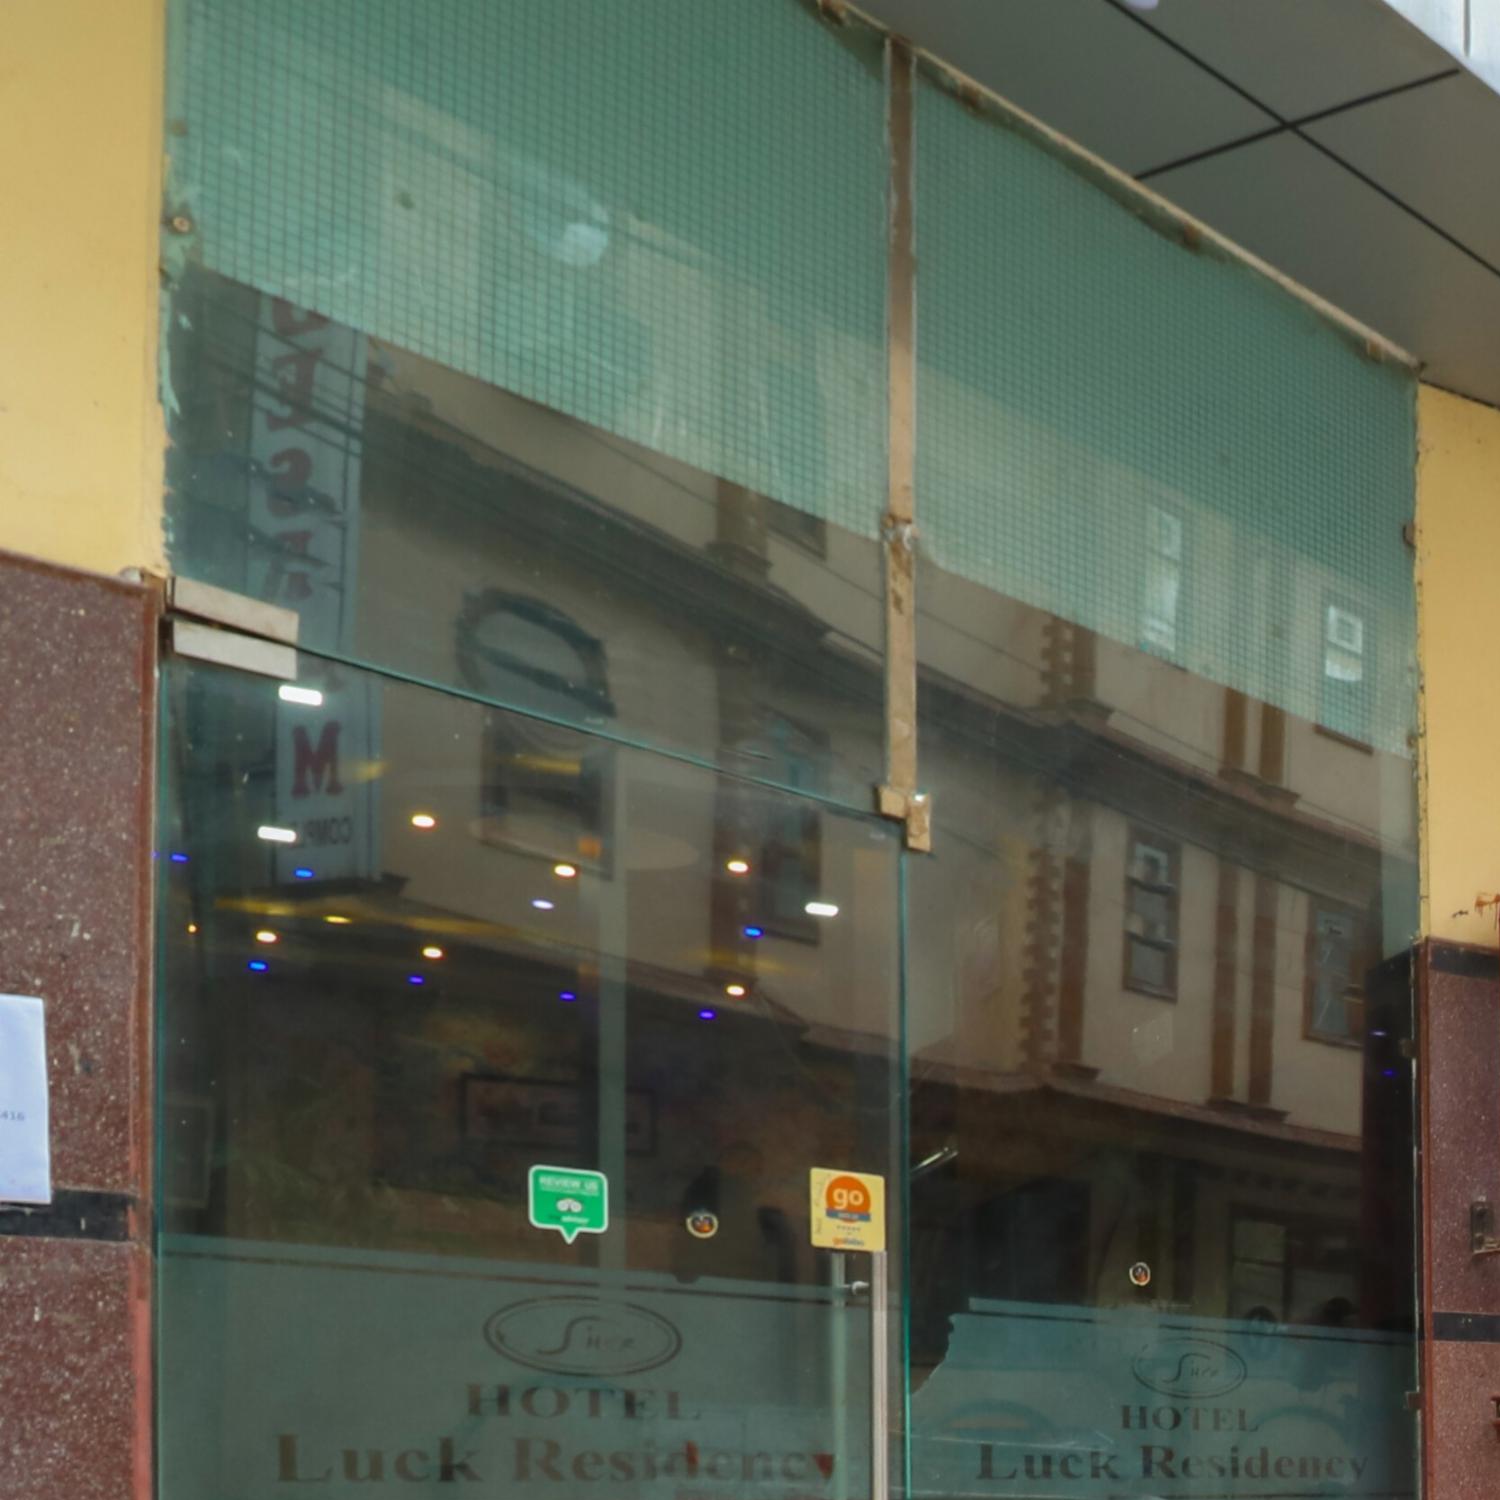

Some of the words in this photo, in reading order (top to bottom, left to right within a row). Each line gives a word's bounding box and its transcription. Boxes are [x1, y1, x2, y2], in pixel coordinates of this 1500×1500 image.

[832, 1187, 865, 1211] go
[466, 1383, 701, 1421] HOTEL
[1121, 1404, 1259, 1433] HOTEL
[277, 1434, 483, 1483] Luck
[976, 1443, 1120, 1480] Luck
[1140, 1444, 1369, 1482] Residency
